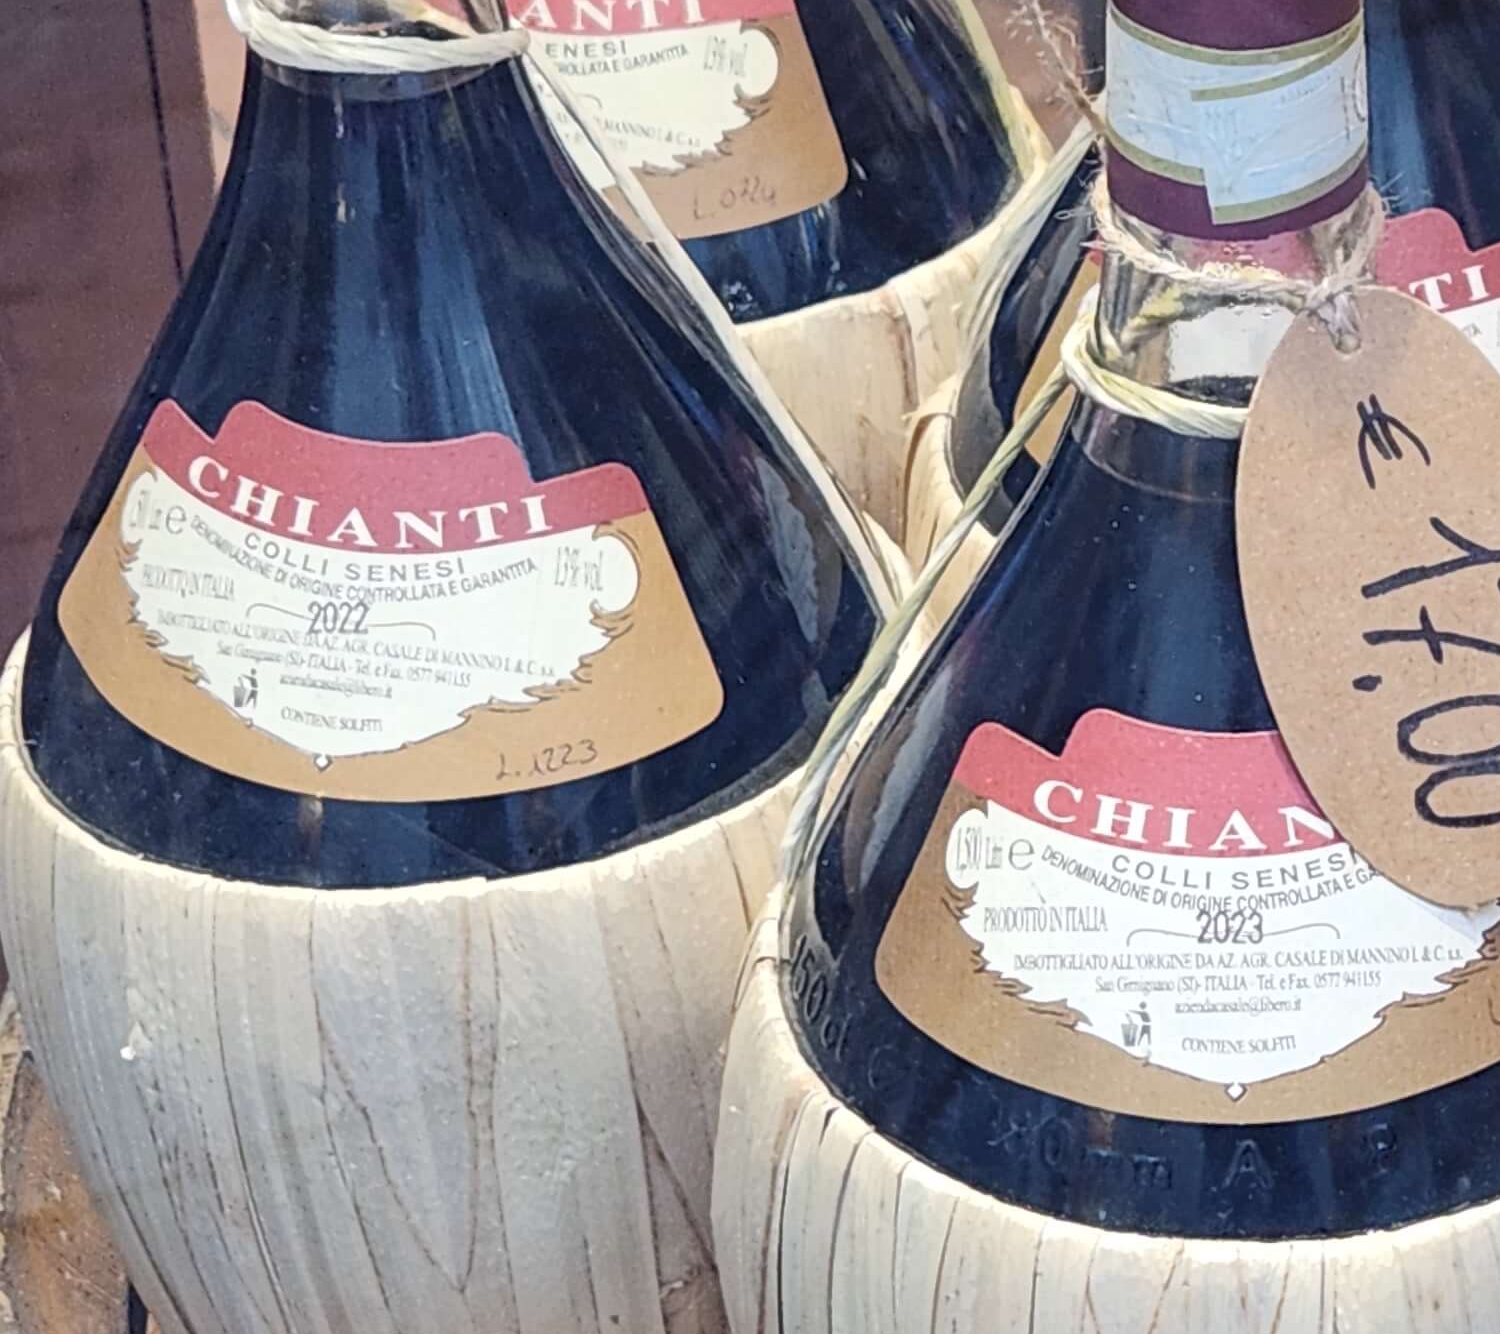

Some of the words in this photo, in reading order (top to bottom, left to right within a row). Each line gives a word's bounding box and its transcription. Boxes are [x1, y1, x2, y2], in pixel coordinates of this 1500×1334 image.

[545, 39, 627, 60] ENESI
[188, 455, 553, 549] CHIANTI
[244, 532, 329, 576] COLLI
[344, 556, 465, 583] SENESI
[289, 572, 344, 600] ORIGINE
[346, 582, 448, 605] CONTROLLATA
[461, 556, 539, 593] GARANTITA
[308, 601, 370, 635] 2022
[1033, 779, 1336, 851] CHIAN
[1041, 845, 1151, 903] DENOMINAZIONE
[1152, 888, 1168, 907] DI
[1170, 891, 1232, 914] ORIGINE
[1236, 880, 1342, 913] CONTROLLATA
[1343, 874, 1356, 889] E
[1111, 854, 1212, 890] COLLI
[1231, 850, 1359, 890] SENESI
[983, 906, 1047, 933] PRODOTTO
[1065, 906, 1109, 932] ITALIA
[1196, 909, 1264, 945] 2023
[1274, 949, 1328, 967] CASALE
[1205, 974, 1248, 993] ITALIA
